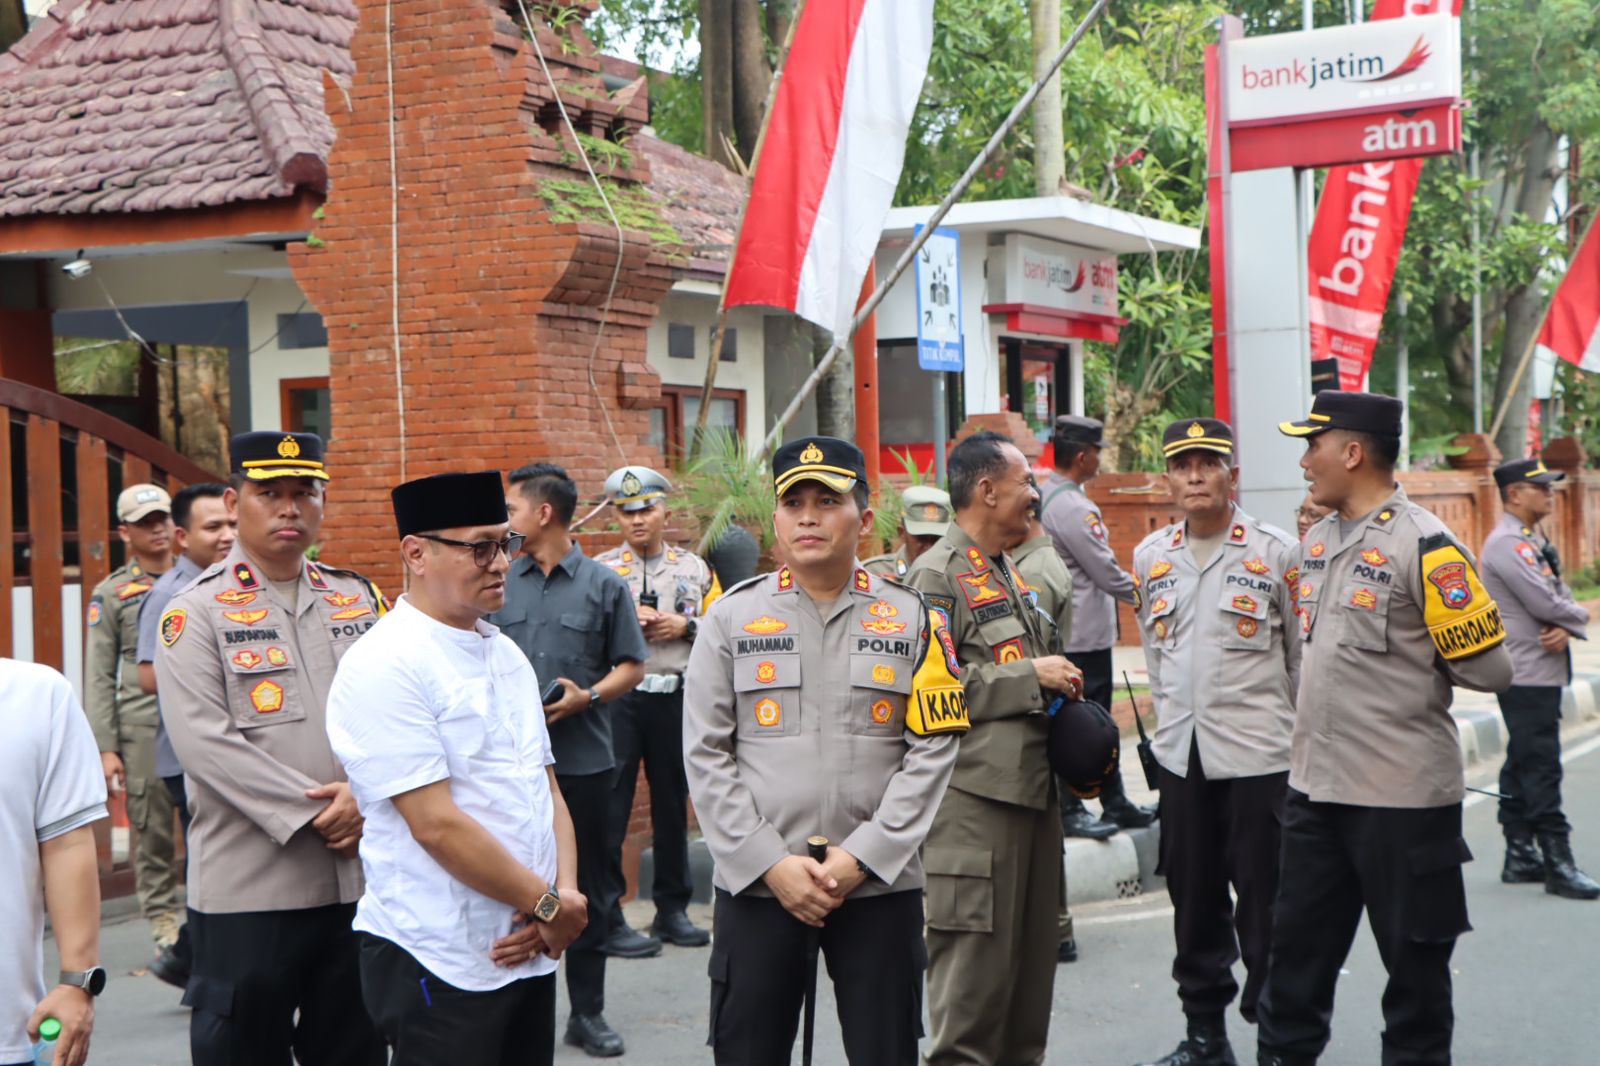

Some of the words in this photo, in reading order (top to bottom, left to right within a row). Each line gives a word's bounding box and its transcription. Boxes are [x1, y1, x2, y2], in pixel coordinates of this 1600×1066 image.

[1242, 53, 1384, 89] bankjatim
[1362, 118, 1436, 152] atm
[1318, 160, 1396, 296] bank
[1092, 262, 1114, 289] atm
[1226, 575, 1273, 593] POLRI
[1353, 564, 1392, 584] POLRI
[1433, 607, 1505, 656] KARENDALOP
[737, 638, 794, 655] MUHAMMAD
[857, 638, 910, 657] POLRI
